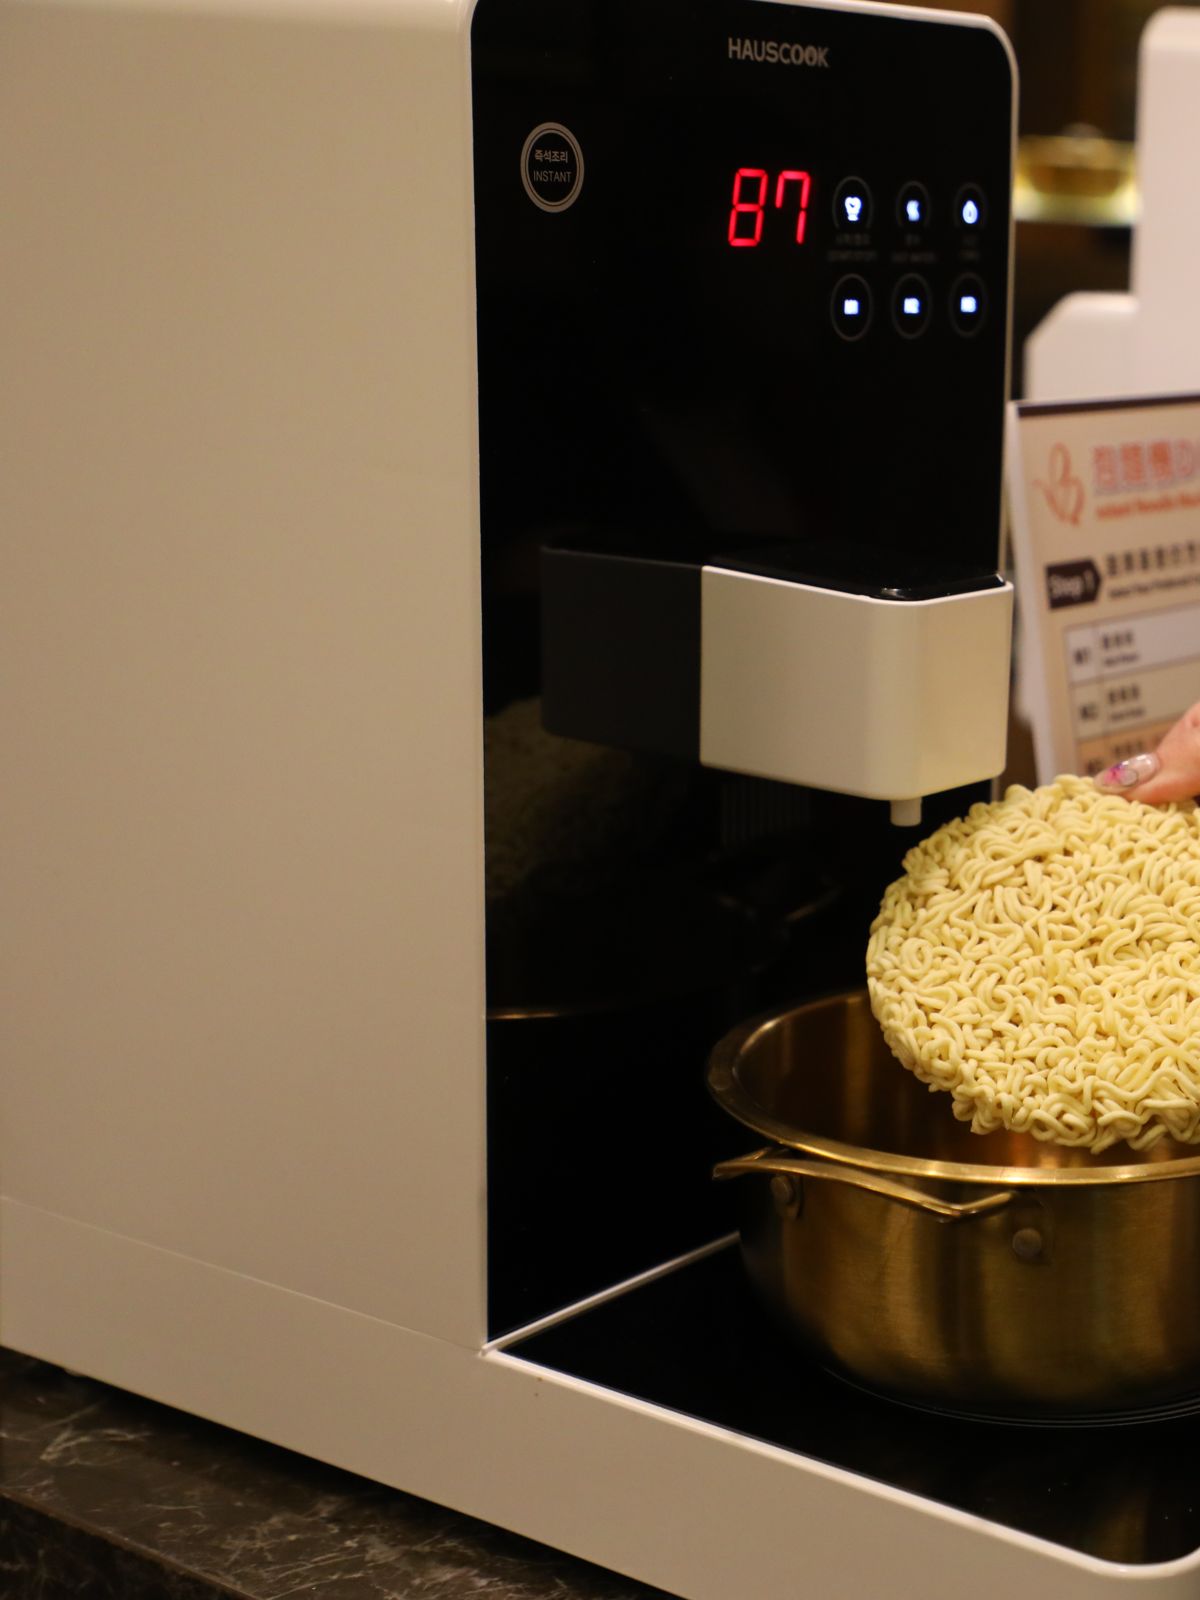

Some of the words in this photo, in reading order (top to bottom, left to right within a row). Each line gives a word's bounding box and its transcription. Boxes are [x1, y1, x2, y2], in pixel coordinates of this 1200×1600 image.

[728, 37, 829, 68] HAUSCOOK
[534, 149, 568, 163] 즉석조리
[533, 170, 572, 182] INSTANT
[728, 167, 810, 247] 87
